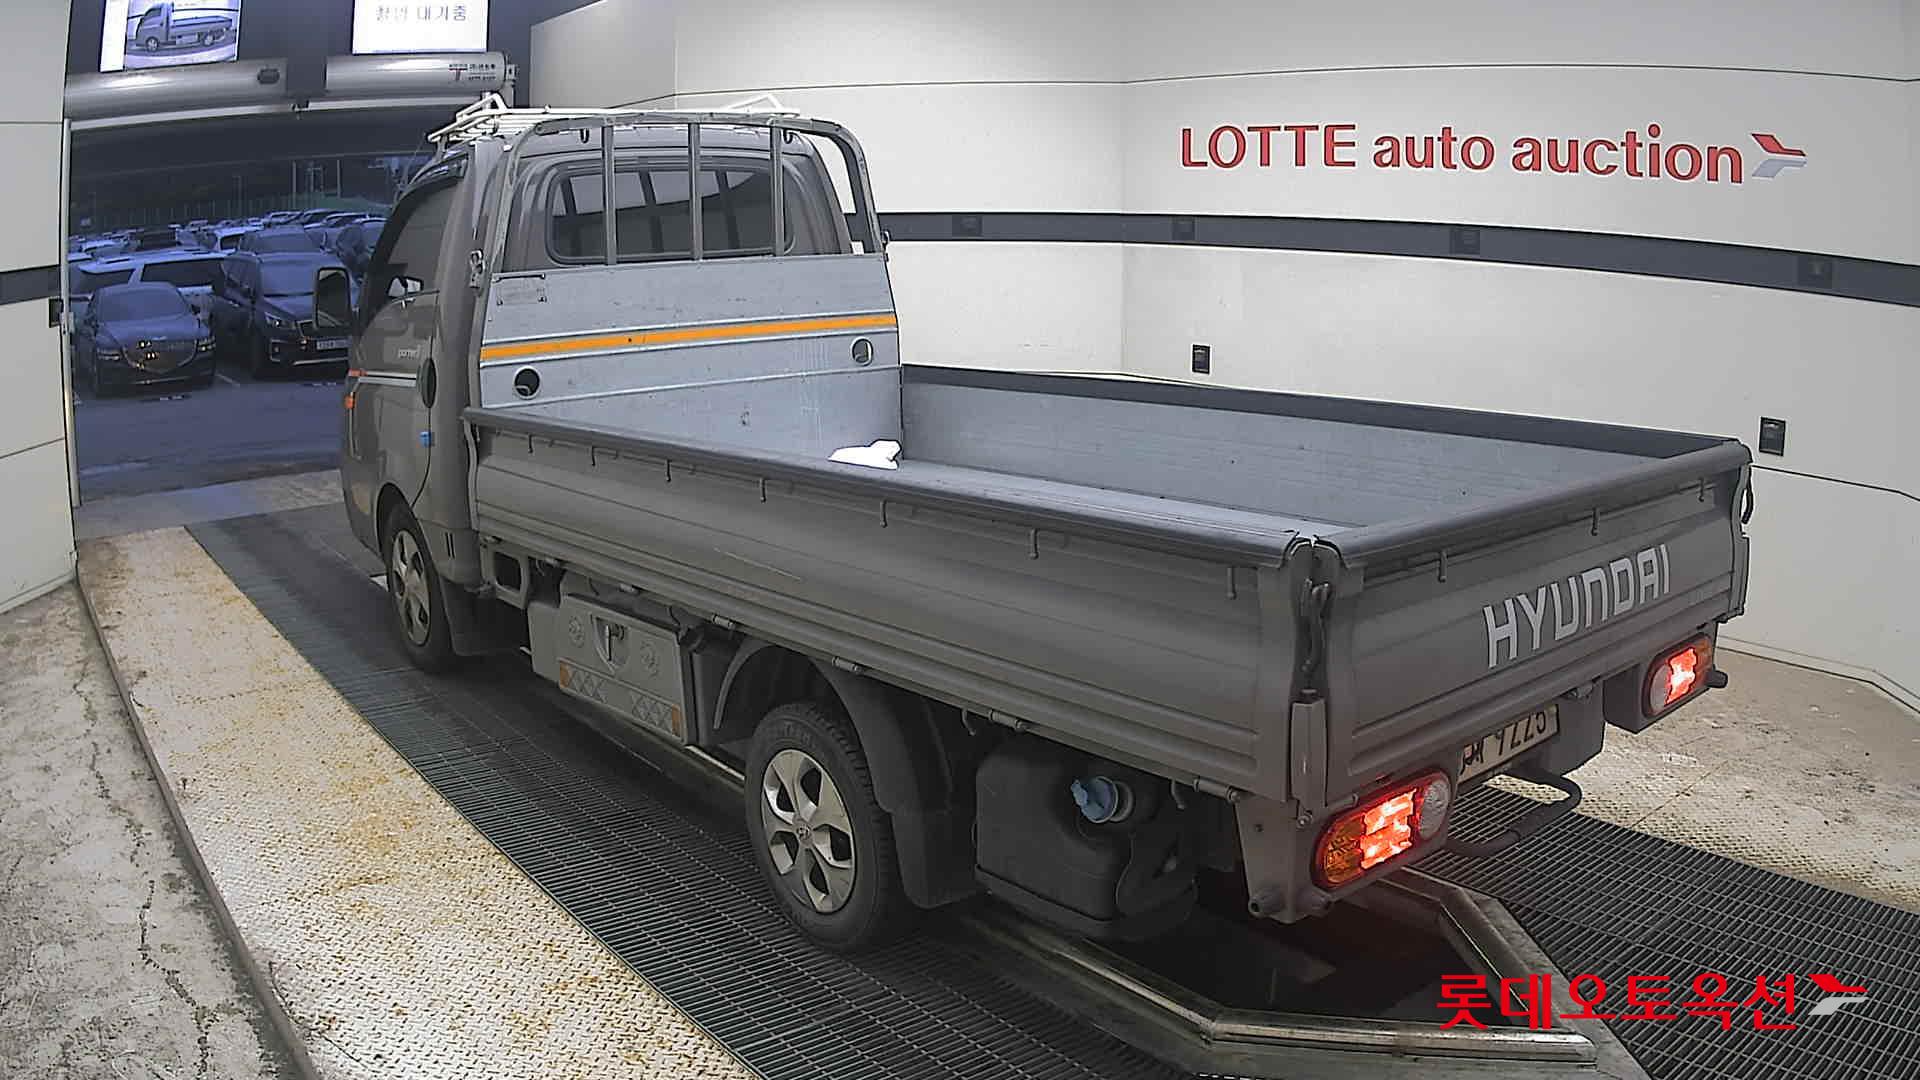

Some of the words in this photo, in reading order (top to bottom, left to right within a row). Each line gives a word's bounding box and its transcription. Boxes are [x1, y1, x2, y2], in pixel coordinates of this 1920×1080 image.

[417, 5, 466, 21] 대기중
[1181, 124, 1356, 169] LOTTE
[1374, 126, 1495, 170] auto
[1512, 124, 1743, 183] auction
[1484, 544, 1670, 668] HYUNDAI
